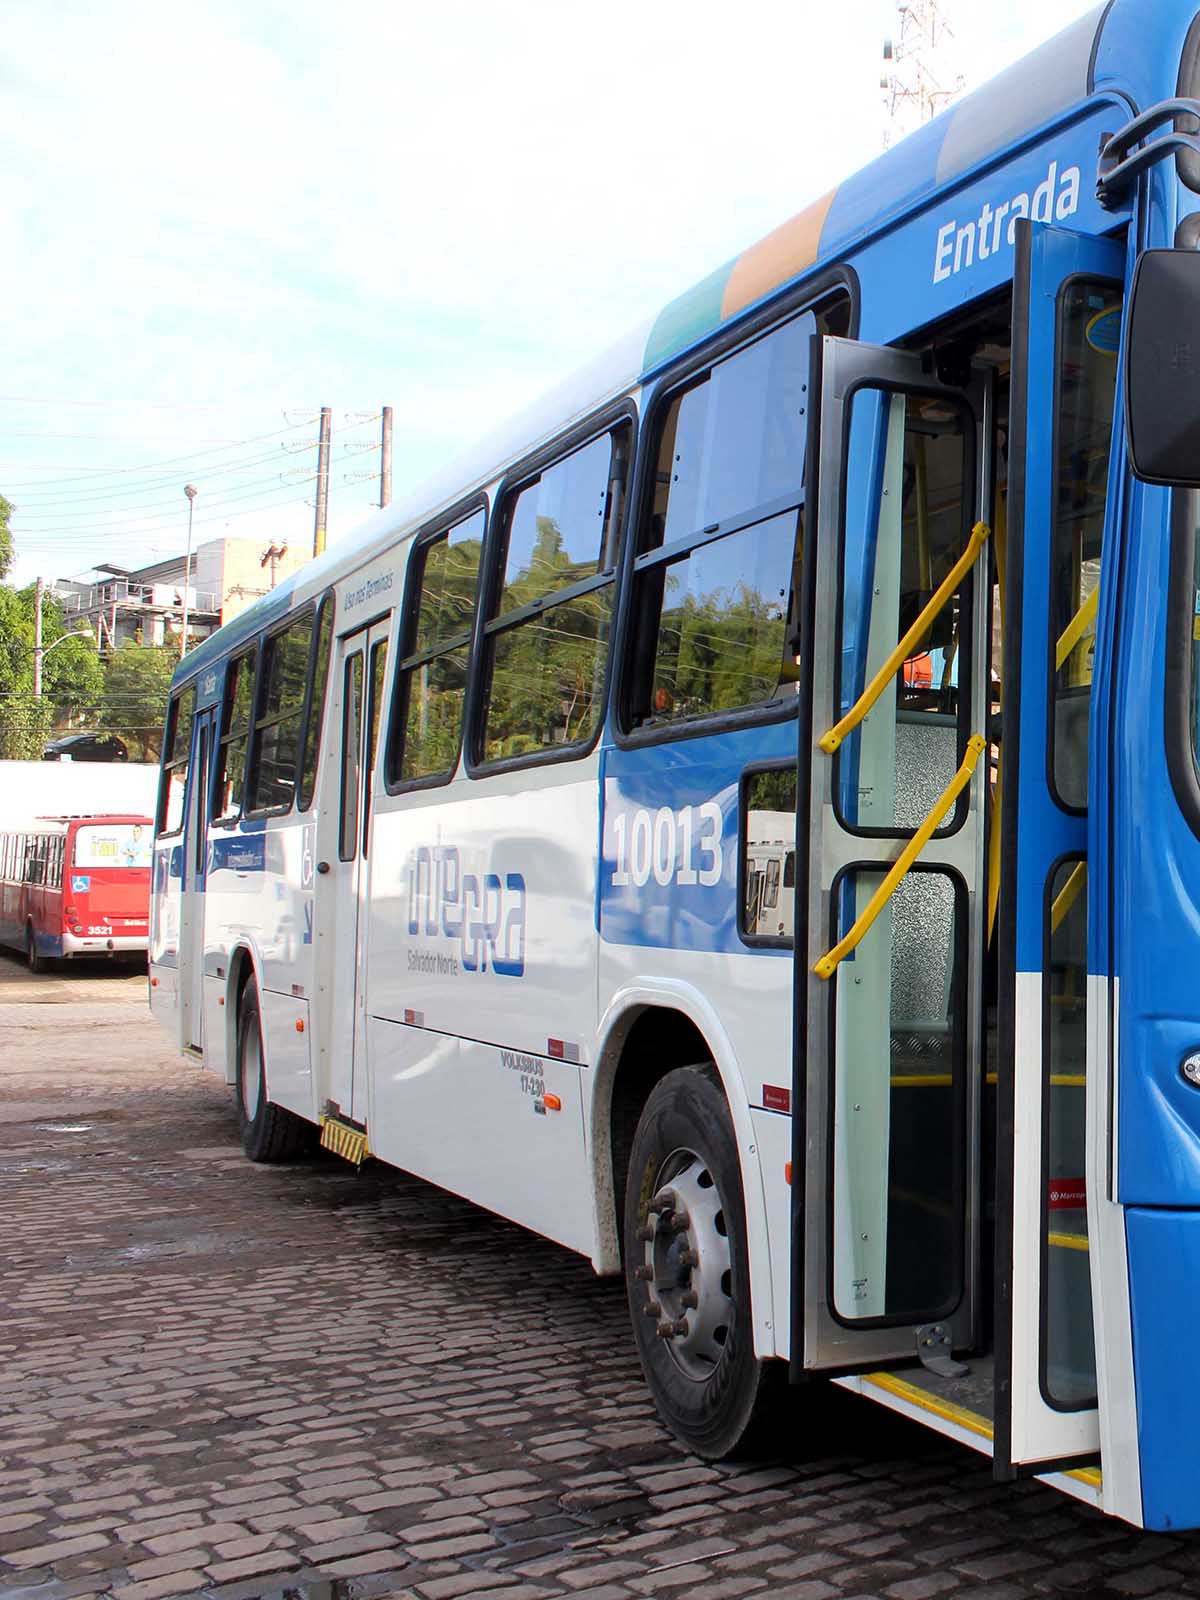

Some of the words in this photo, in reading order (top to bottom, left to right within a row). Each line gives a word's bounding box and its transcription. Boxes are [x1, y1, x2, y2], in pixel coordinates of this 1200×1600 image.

[933, 160, 1080, 284] Entrada
[611, 802, 723, 887] 10013
[88, 926, 113, 935] 3521
[437, 951, 459, 977] Norte
[500, 1050, 544, 1077] VOLKSBUS
